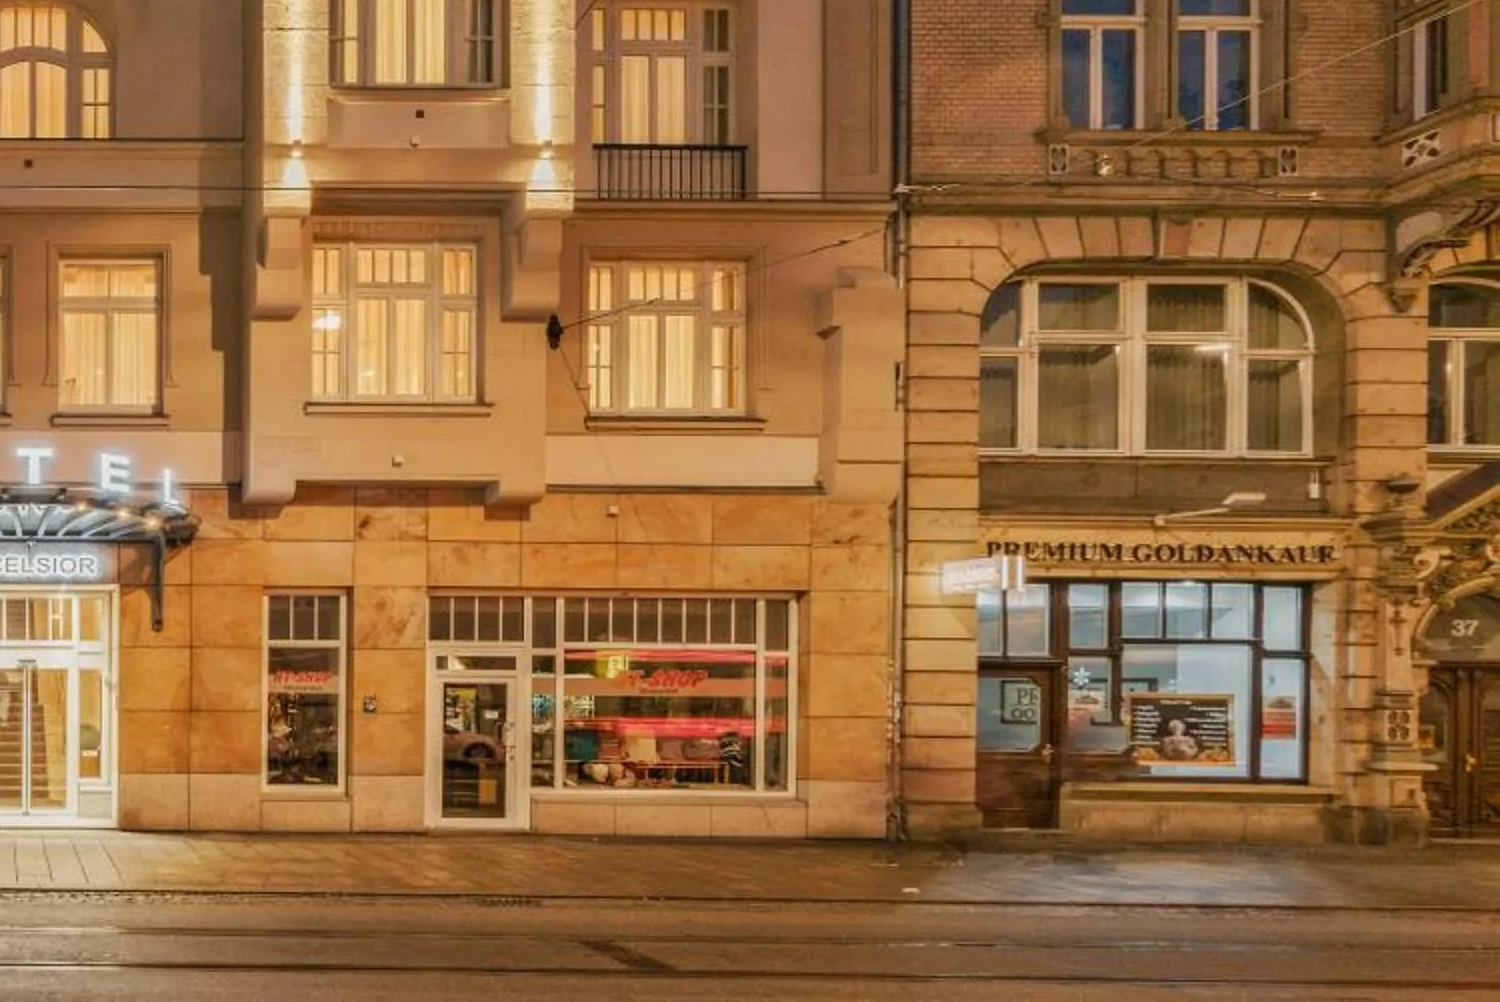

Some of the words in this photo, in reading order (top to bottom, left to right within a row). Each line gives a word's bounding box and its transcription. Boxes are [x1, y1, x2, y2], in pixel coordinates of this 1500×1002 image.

[986, 541, 1122, 562] PREMIUM
[1132, 543, 1337, 564] GOLDANKAUF
[1451, 619, 1479, 637] 37
